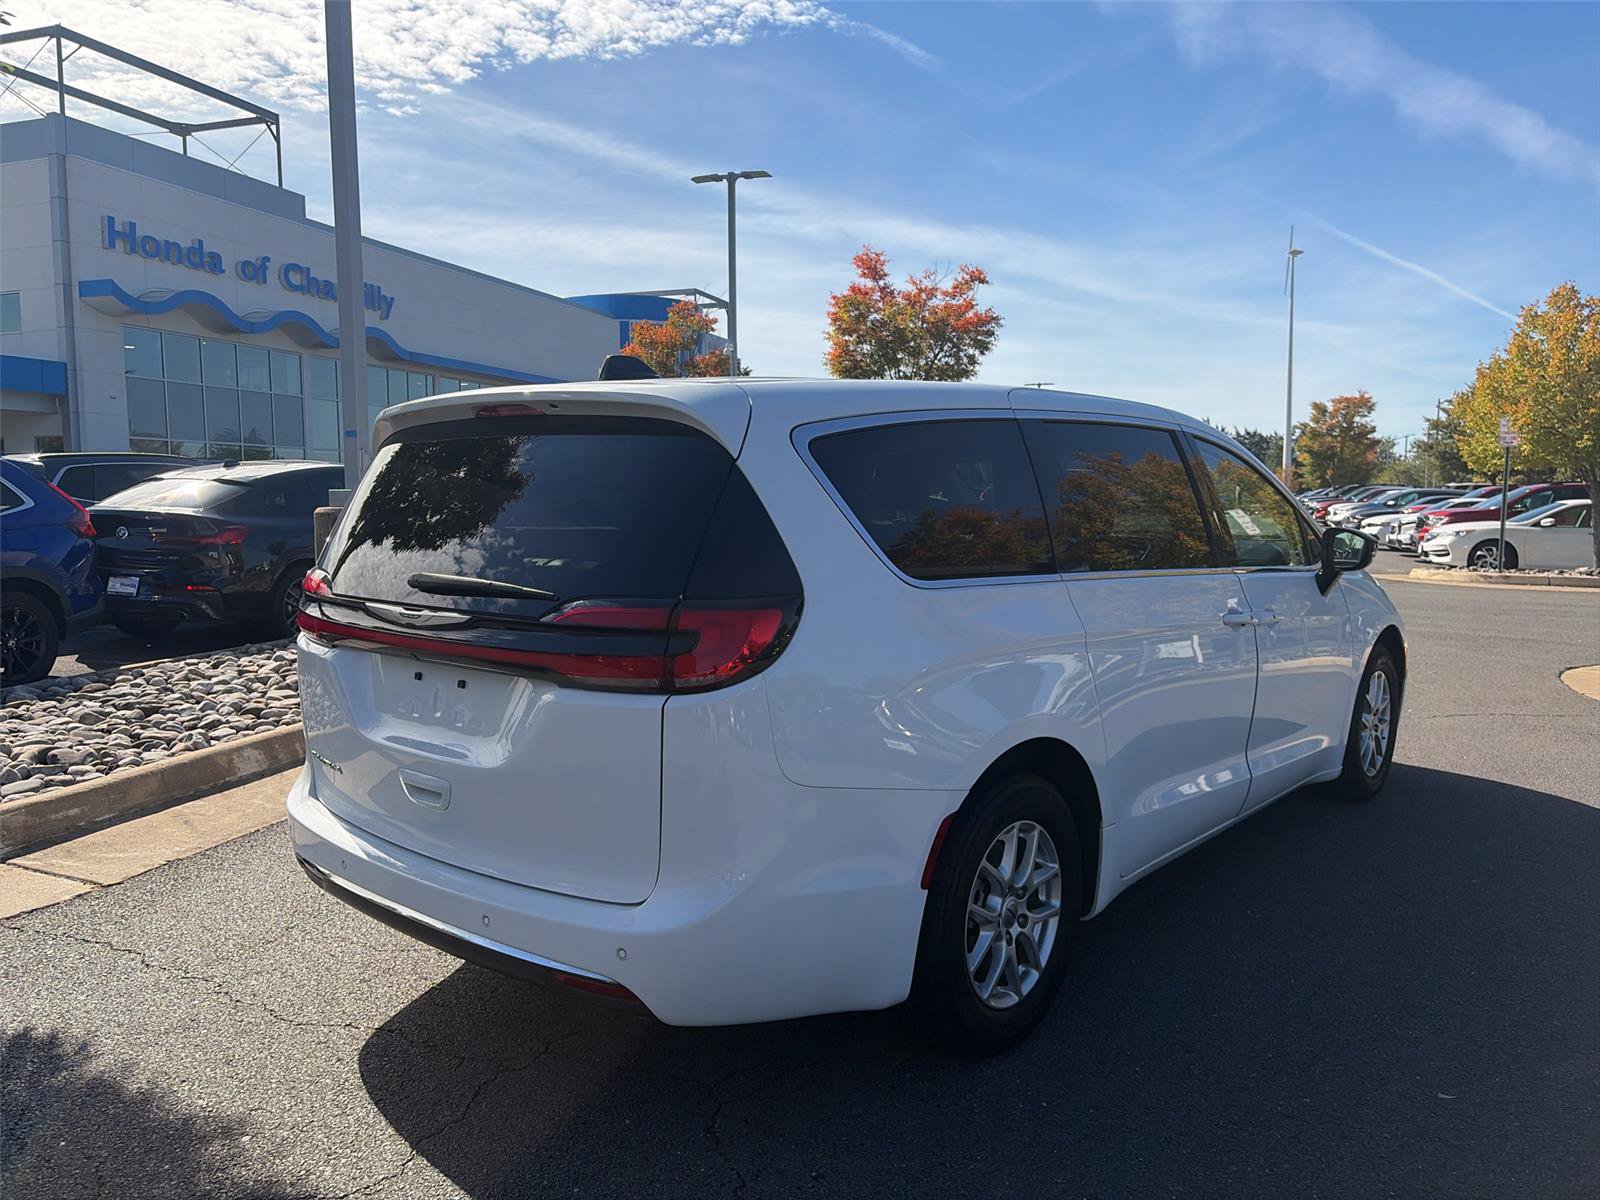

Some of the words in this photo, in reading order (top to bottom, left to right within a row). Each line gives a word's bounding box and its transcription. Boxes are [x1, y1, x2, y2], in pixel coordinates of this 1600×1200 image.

[102, 215, 225, 275] Honda
[235, 256, 271, 285] of
[278, 262, 395, 320] Chailly
